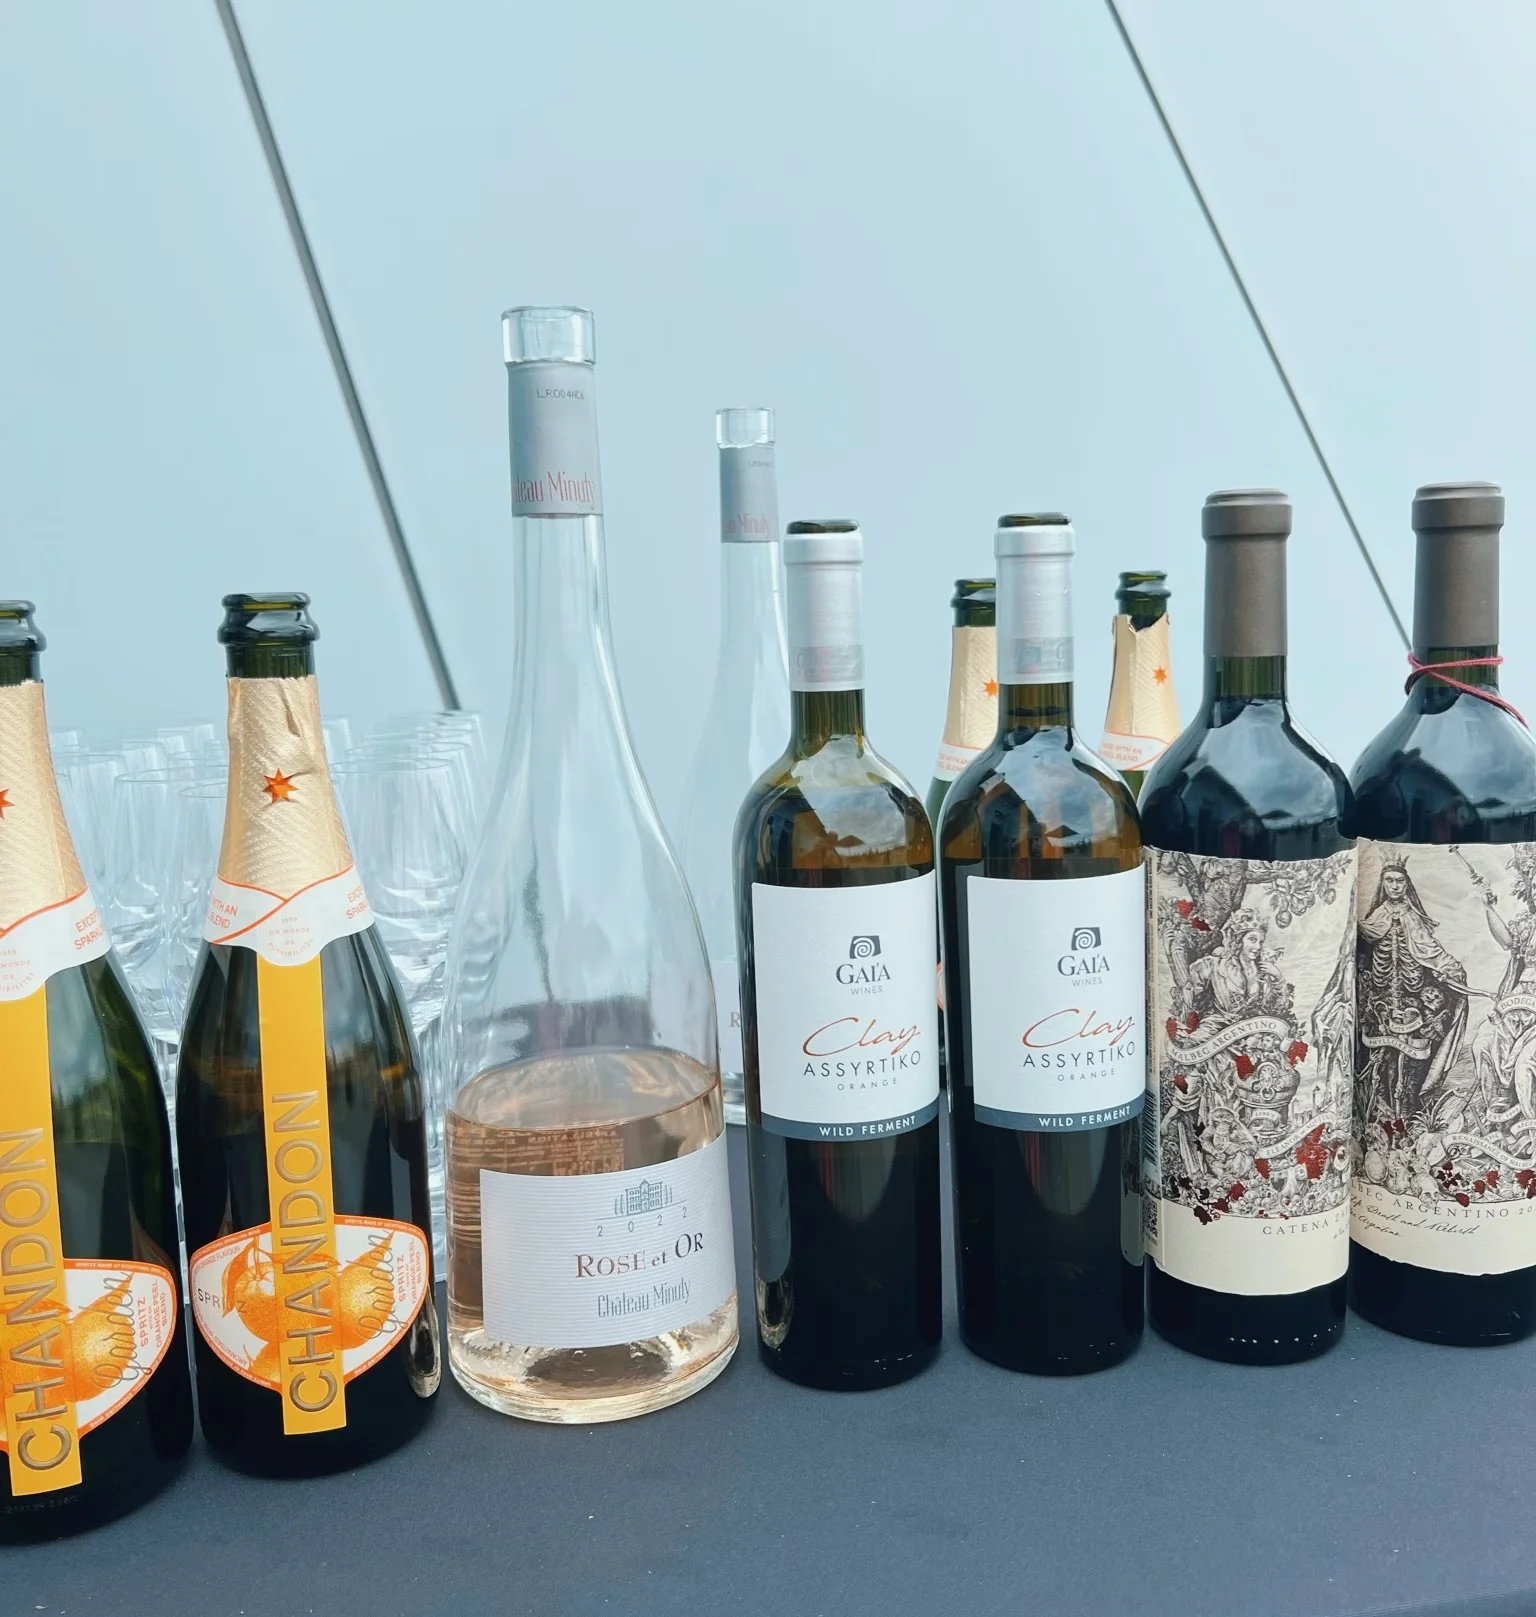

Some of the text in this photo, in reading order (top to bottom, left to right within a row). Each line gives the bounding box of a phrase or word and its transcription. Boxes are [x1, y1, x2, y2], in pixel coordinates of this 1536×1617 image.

[547, 471, 595, 510] Minuty
[224, 903, 239, 917] AN
[850, 985, 883, 995] WINES
[1071, 976, 1103, 988] WINES
[802, 1016, 921, 1057] Clay
[1022, 1008, 1135, 1049] Clay
[1171, 1020, 1277, 1062] MALBEC ARGENTINO
[803, 1051, 921, 1078] ASSYRTIKO
[1022, 1041, 1136, 1069] ASSYRTIKO
[837, 1077, 897, 1091] ORANGE
[1057, 1068, 1116, 1082] ORANGE
[819, 1115, 916, 1137] WILD FERMENT
[1038, 1105, 1131, 1128] WILD FERMENT
[1266, 1134, 1299, 1155] ELEANOR
[1393, 1198, 1509, 1219] ARGENTINO
[1262, 1218, 1329, 1235] CATENA
[272, 1089, 338, 1413] CHANDON
[651, 1250, 668, 1267] et
[675, 1232, 704, 1258] OR
[396, 1254, 407, 1303] SPRITZ
[0, 1127, 73, 1471] CHANDON
[160, 1292, 168, 1327] BLEND
[197, 1288, 248, 1313] SPRZ
[597, 1276, 692, 1318] Château Minuty
[138, 1296, 149, 1347] SPRITZ
[151, 1279, 163, 1348] ORANGE PEEL
[79, 1272, 152, 1388] Garden
